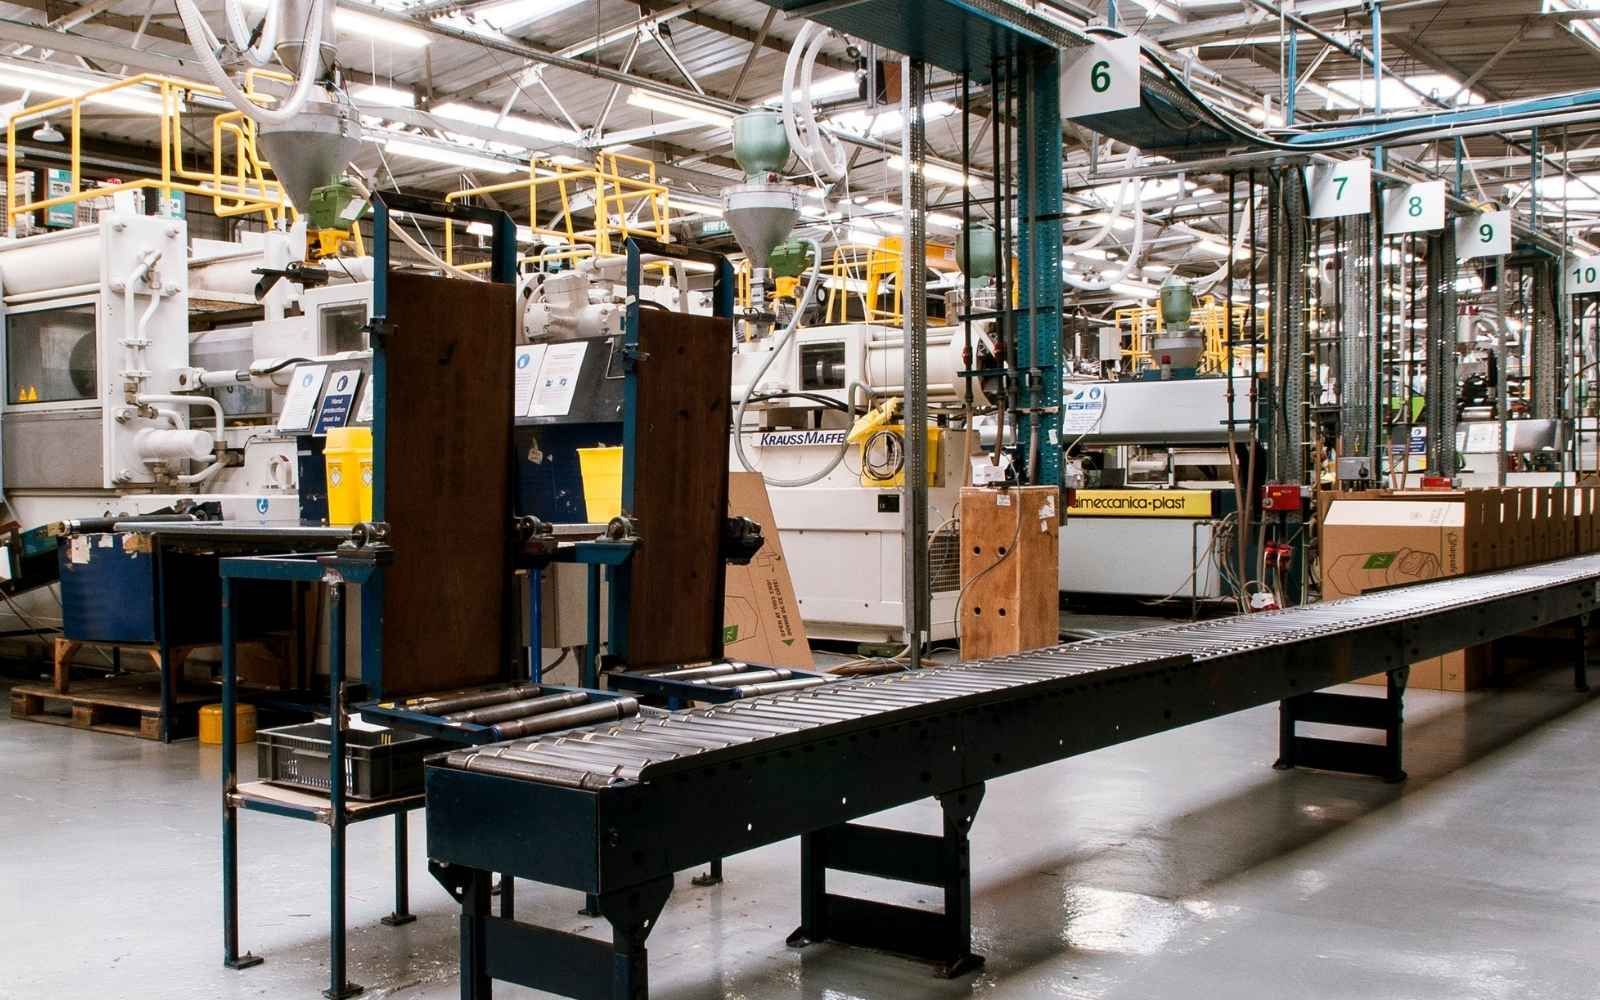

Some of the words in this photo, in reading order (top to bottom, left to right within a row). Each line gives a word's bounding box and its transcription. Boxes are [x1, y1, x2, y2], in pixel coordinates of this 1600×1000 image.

[1091, 61, 1111, 93] 6
[1333, 177, 1348, 200] 7
[1409, 196, 1423, 216] 8
[1480, 224, 1494, 243] 9
[1573, 267, 1596, 284] 10
[760, 432, 846, 446] KRAUSSMAFFE
